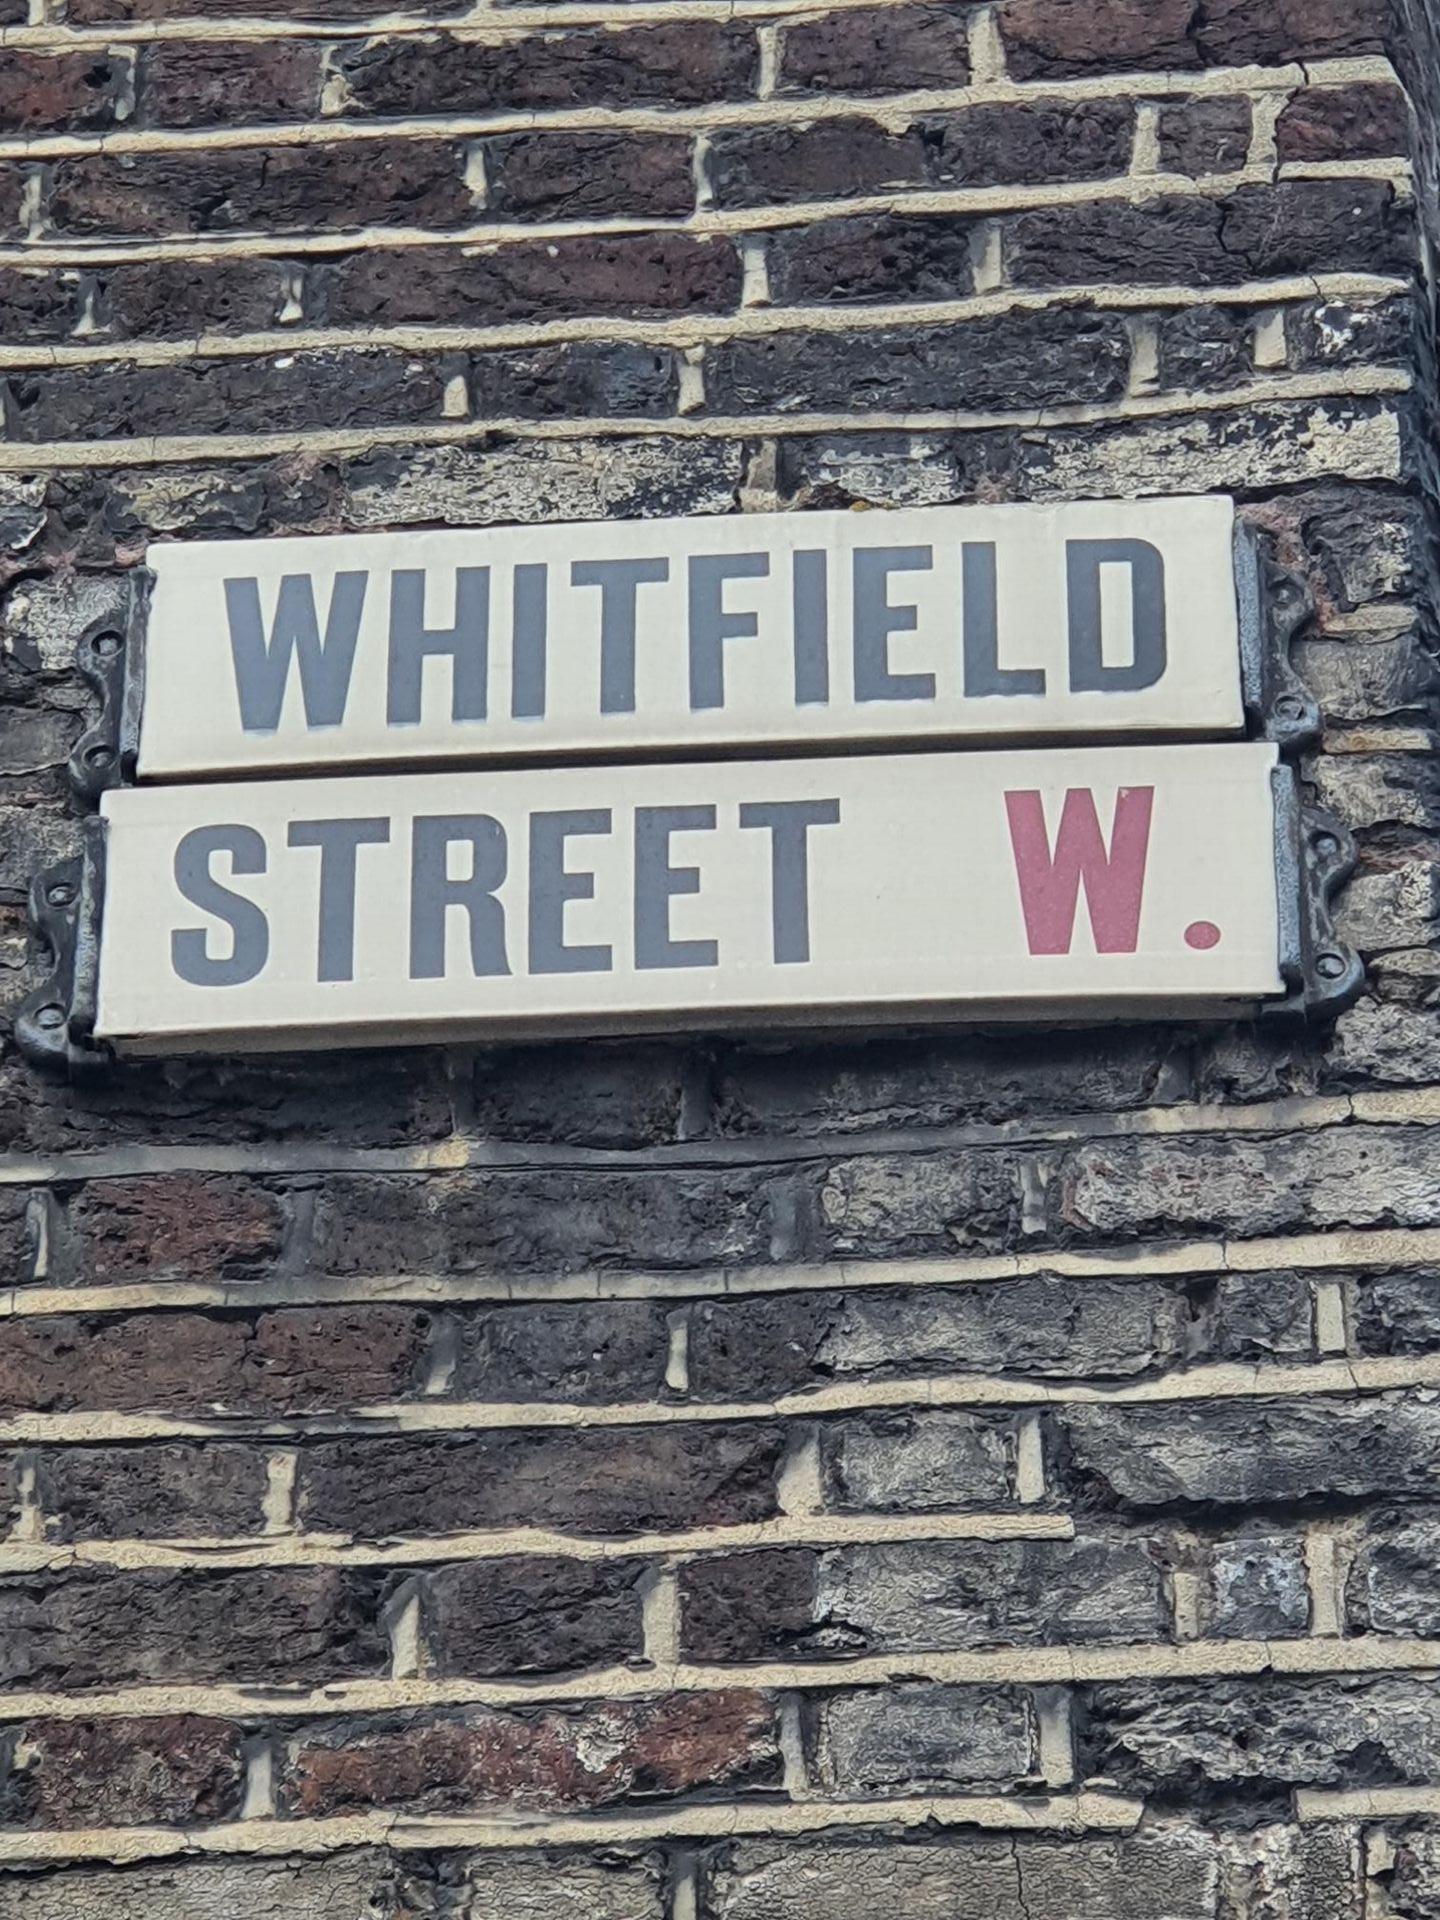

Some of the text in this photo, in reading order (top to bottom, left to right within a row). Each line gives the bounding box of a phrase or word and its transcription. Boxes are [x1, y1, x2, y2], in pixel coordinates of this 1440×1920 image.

[224, 538, 1167, 731] WHITFIELD
[172, 786, 1221, 986] STREET W.
